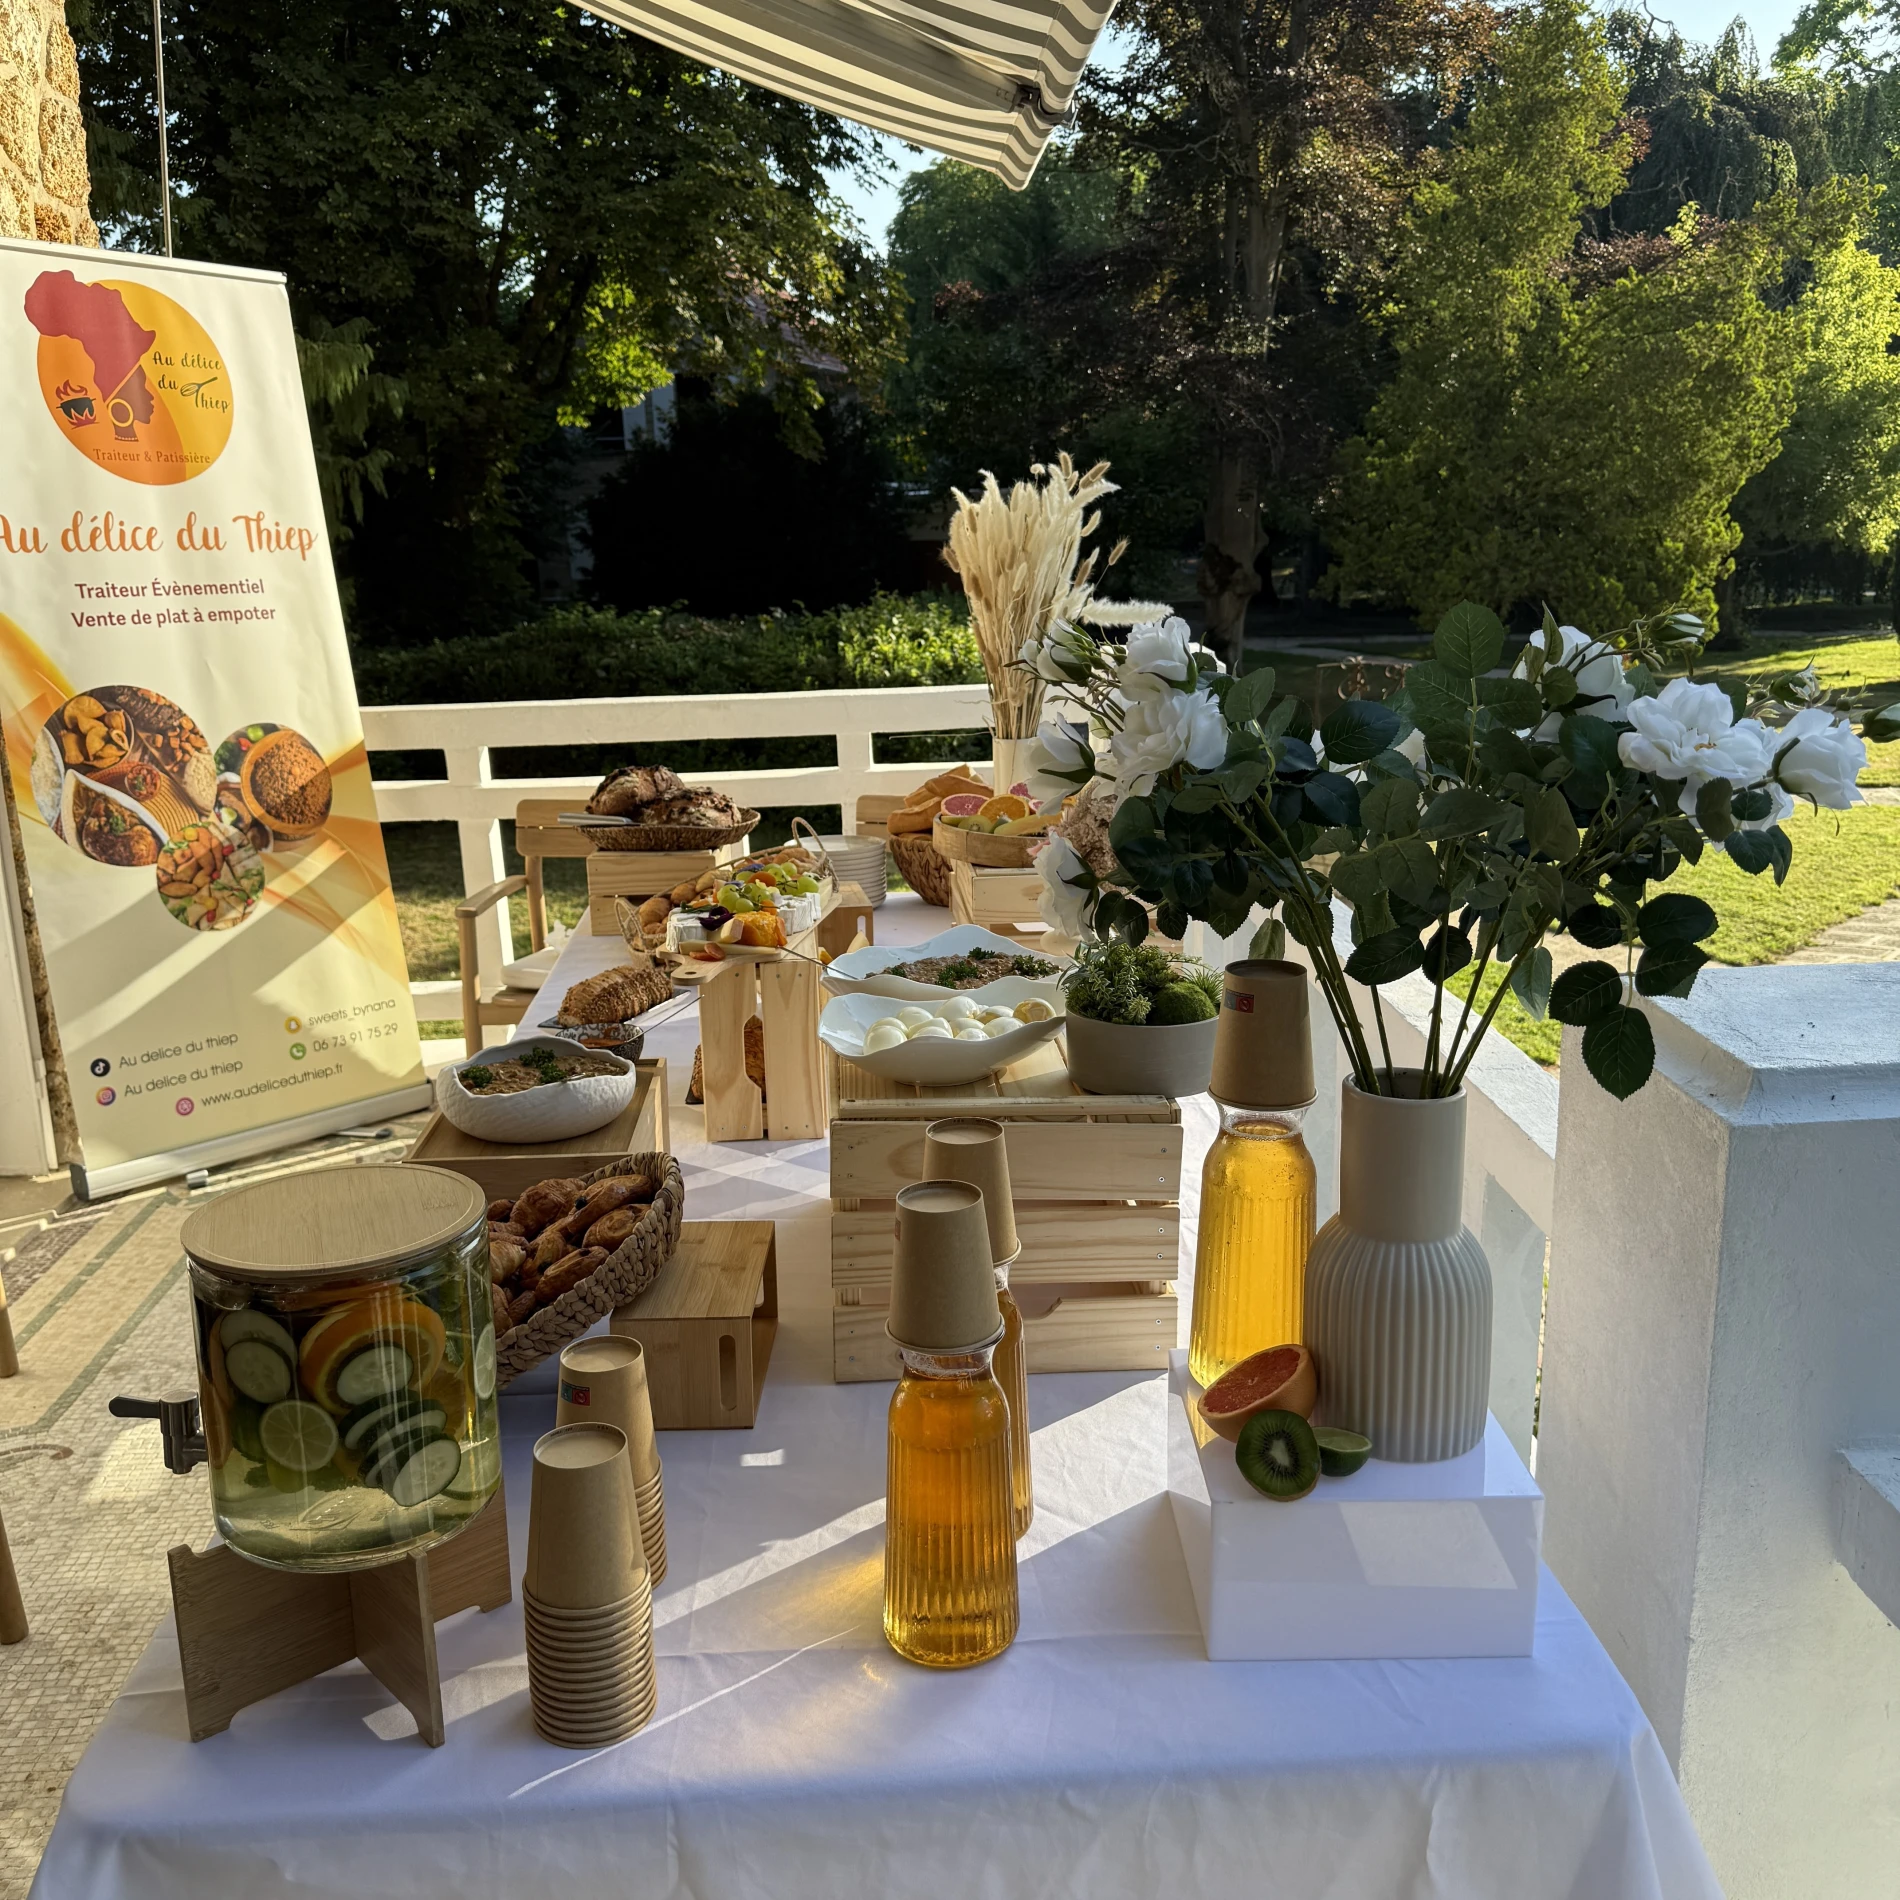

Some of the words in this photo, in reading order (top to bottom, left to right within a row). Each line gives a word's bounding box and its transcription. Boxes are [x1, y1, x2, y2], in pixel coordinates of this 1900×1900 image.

[152, 350, 175, 367] Au
[181, 352, 221, 370] délice
[157, 373, 179, 390] du
[195, 384, 230, 414] Thiep
[92, 448, 141, 462] Traiteur
[144, 450, 153, 462] &
[156, 450, 211, 464] Patissière
[61, 510, 164, 553] délice
[177, 511, 227, 551] du
[232, 511, 318, 561] Thiep
[74, 581, 147, 599] Traiteur
[151, 577, 265, 597] Évènementiel
[71, 611, 126, 628] Vente
[131, 609, 152, 625] de
[156, 608, 190, 628] plat
[193, 607, 204, 623] à
[208, 606, 276, 625] empoter
[308, 999, 396, 1027] sweets_bynana
[119, 1055, 138, 1069] Au
[140, 1046, 182, 1063] delice
[185, 1040, 203, 1054] du
[206, 1033, 239, 1049] thiep
[313, 1039, 329, 1052] 06
[332, 1034, 347, 1048] 73
[349, 1031, 363, 1044] 91
[367, 1026, 382, 1039] 75
[384, 1022, 398, 1036] 29
[124, 1084, 143, 1097] Au
[145, 1074, 187, 1092] delice
[190, 1068, 208, 1081] du
[210, 1060, 243, 1076] thiep
[201, 1062, 343, 1107] www.audeliceduthiep.fr
